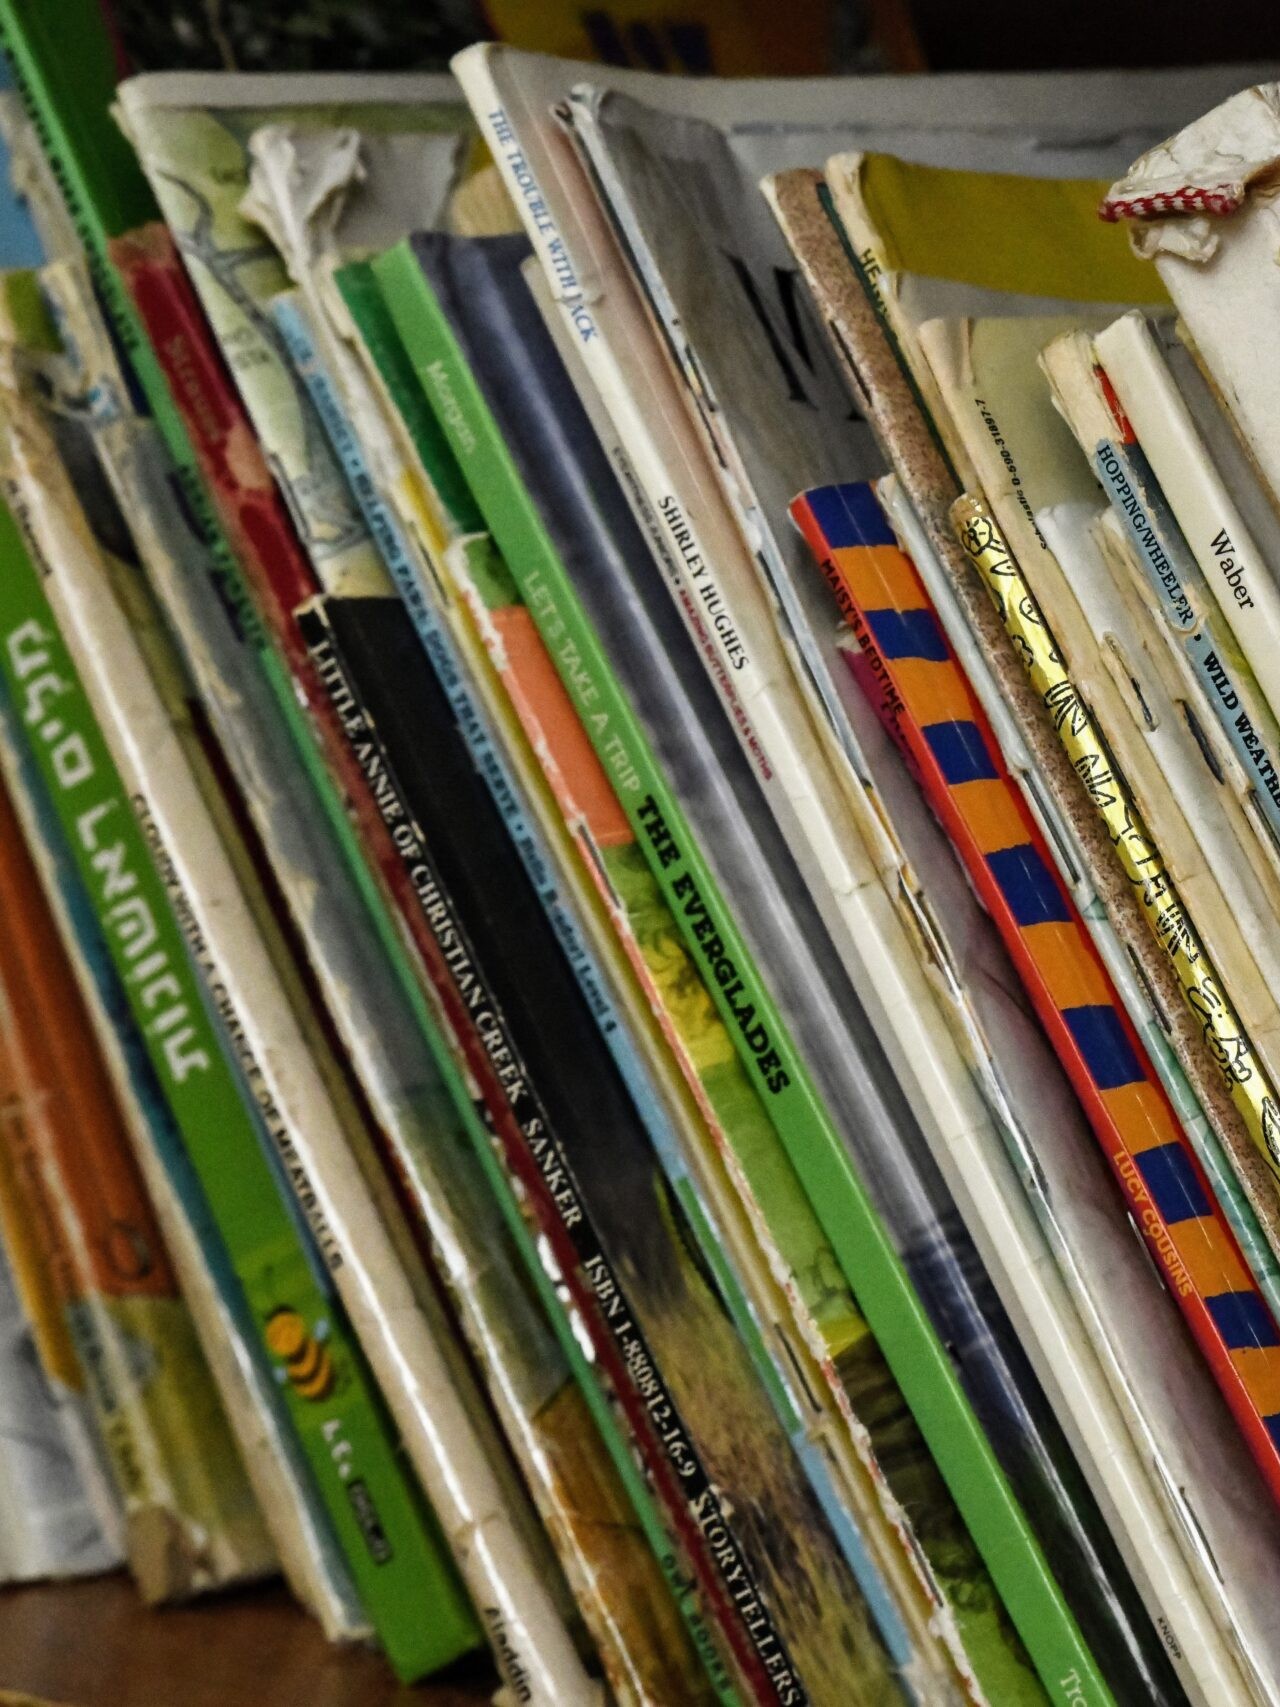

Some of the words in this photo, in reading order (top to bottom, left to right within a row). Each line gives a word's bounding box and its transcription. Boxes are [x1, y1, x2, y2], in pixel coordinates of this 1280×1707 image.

[485, 107, 514, 148] THE
[503, 149, 553, 237] TROUBLE
[542, 237, 577, 292] WITH
[564, 289, 599, 344] JACK
[422, 357, 482, 455] Morgan
[655, 493, 709, 582] SHIRLEY
[698, 582, 752, 672] HUGHES
[1093, 444, 1197, 625] HOPPING/WHEELER
[1205, 527, 1261, 613] Waber
[520, 569, 568, 642] LET'S
[818, 559, 864, 633] MAISY'S
[856, 633, 906, 716] BEDTIME
[452, 690, 488, 746] THAT
[553, 637, 601, 709] TAKE
[588, 708, 613, 734] A
[677, 587, 709, 644] AMAZING
[703, 643, 747, 727] BUTTERFLIES
[747, 736, 773, 782] MOTHS
[1199, 650, 1241, 712] WILD
[600, 733, 643, 795] TRIP
[630, 793, 684, 871] THE
[668, 870, 794, 1097] EVERGLADES
[209, 980, 263, 1080] CHANCE
[254, 1084, 282, 1125] OF
[272, 1126, 345, 1271] MEATBALLS
[306, 639, 368, 739] LITTLE
[350, 736, 407, 826] ANNIE
[388, 821, 423, 862] OF
[406, 861, 490, 1013] CHRISTIAN
[471, 1006, 532, 1106] CREEK
[520, 1115, 588, 1230] SANKER
[582, 1253, 628, 1321] ISBN
[611, 1317, 701, 1482] 1-880812-16-9
[686, 1488, 806, 1707] STORYTELLERS
[1110, 1150, 1147, 1206] LUCY
[1139, 1207, 1194, 1298] COUSINS
[481, 1604, 537, 1705] Aladdin
[659, 1554, 692, 1603] OWL
[686, 1611, 735, 1692] BOOKS
